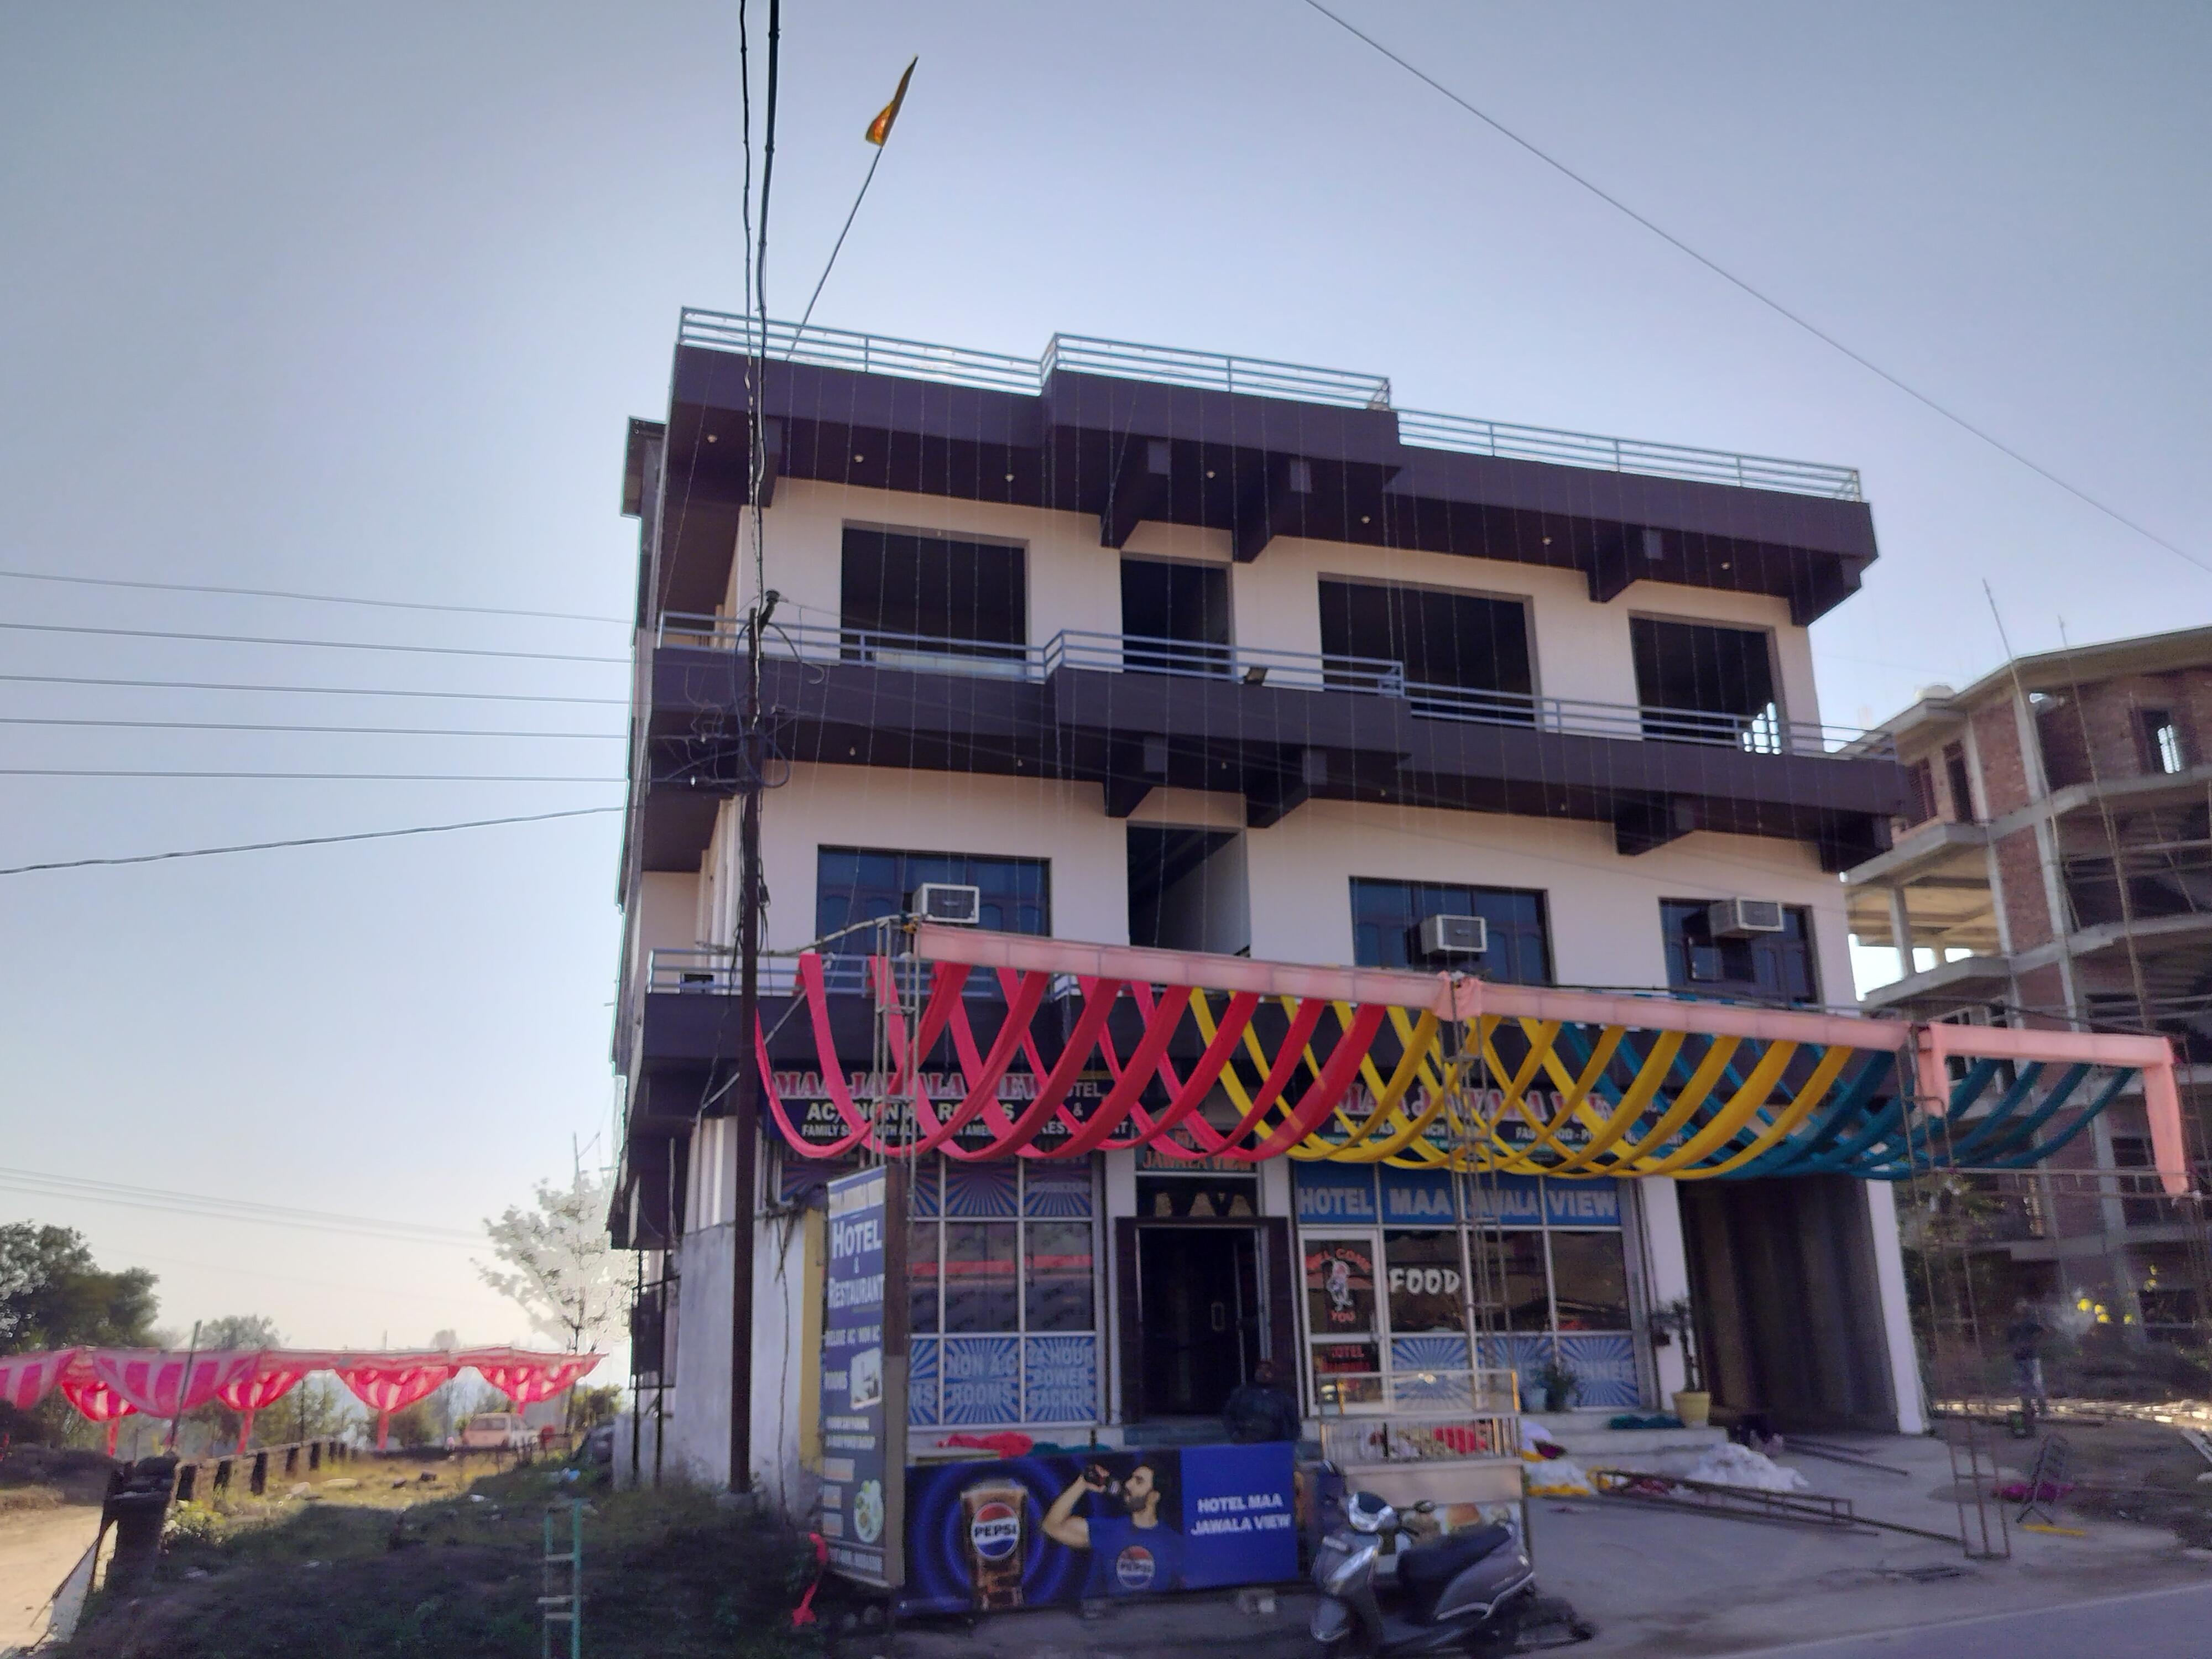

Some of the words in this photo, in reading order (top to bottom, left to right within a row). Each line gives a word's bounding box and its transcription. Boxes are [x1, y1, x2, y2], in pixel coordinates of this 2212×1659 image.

[1073, 1102, 1083, 1117] &
[802, 1124, 839, 1137] FAMILY
[1296, 1187, 1374, 1215] HOTEL
[1389, 1188, 1453, 1215] MAA
[1547, 1190, 1615, 1218] VIEW
[832, 1219, 883, 1260] HOTEL
[828, 1274, 884, 1310] RESTAURANT
[1389, 1267, 1460, 1295] FOOD
[949, 1384, 1012, 1406] ROOMS
[1197, 1495, 1246, 1514] HOTEL
[1248, 1492, 1284, 1509] MAA
[974, 1524, 1017, 1537] PEPSI
